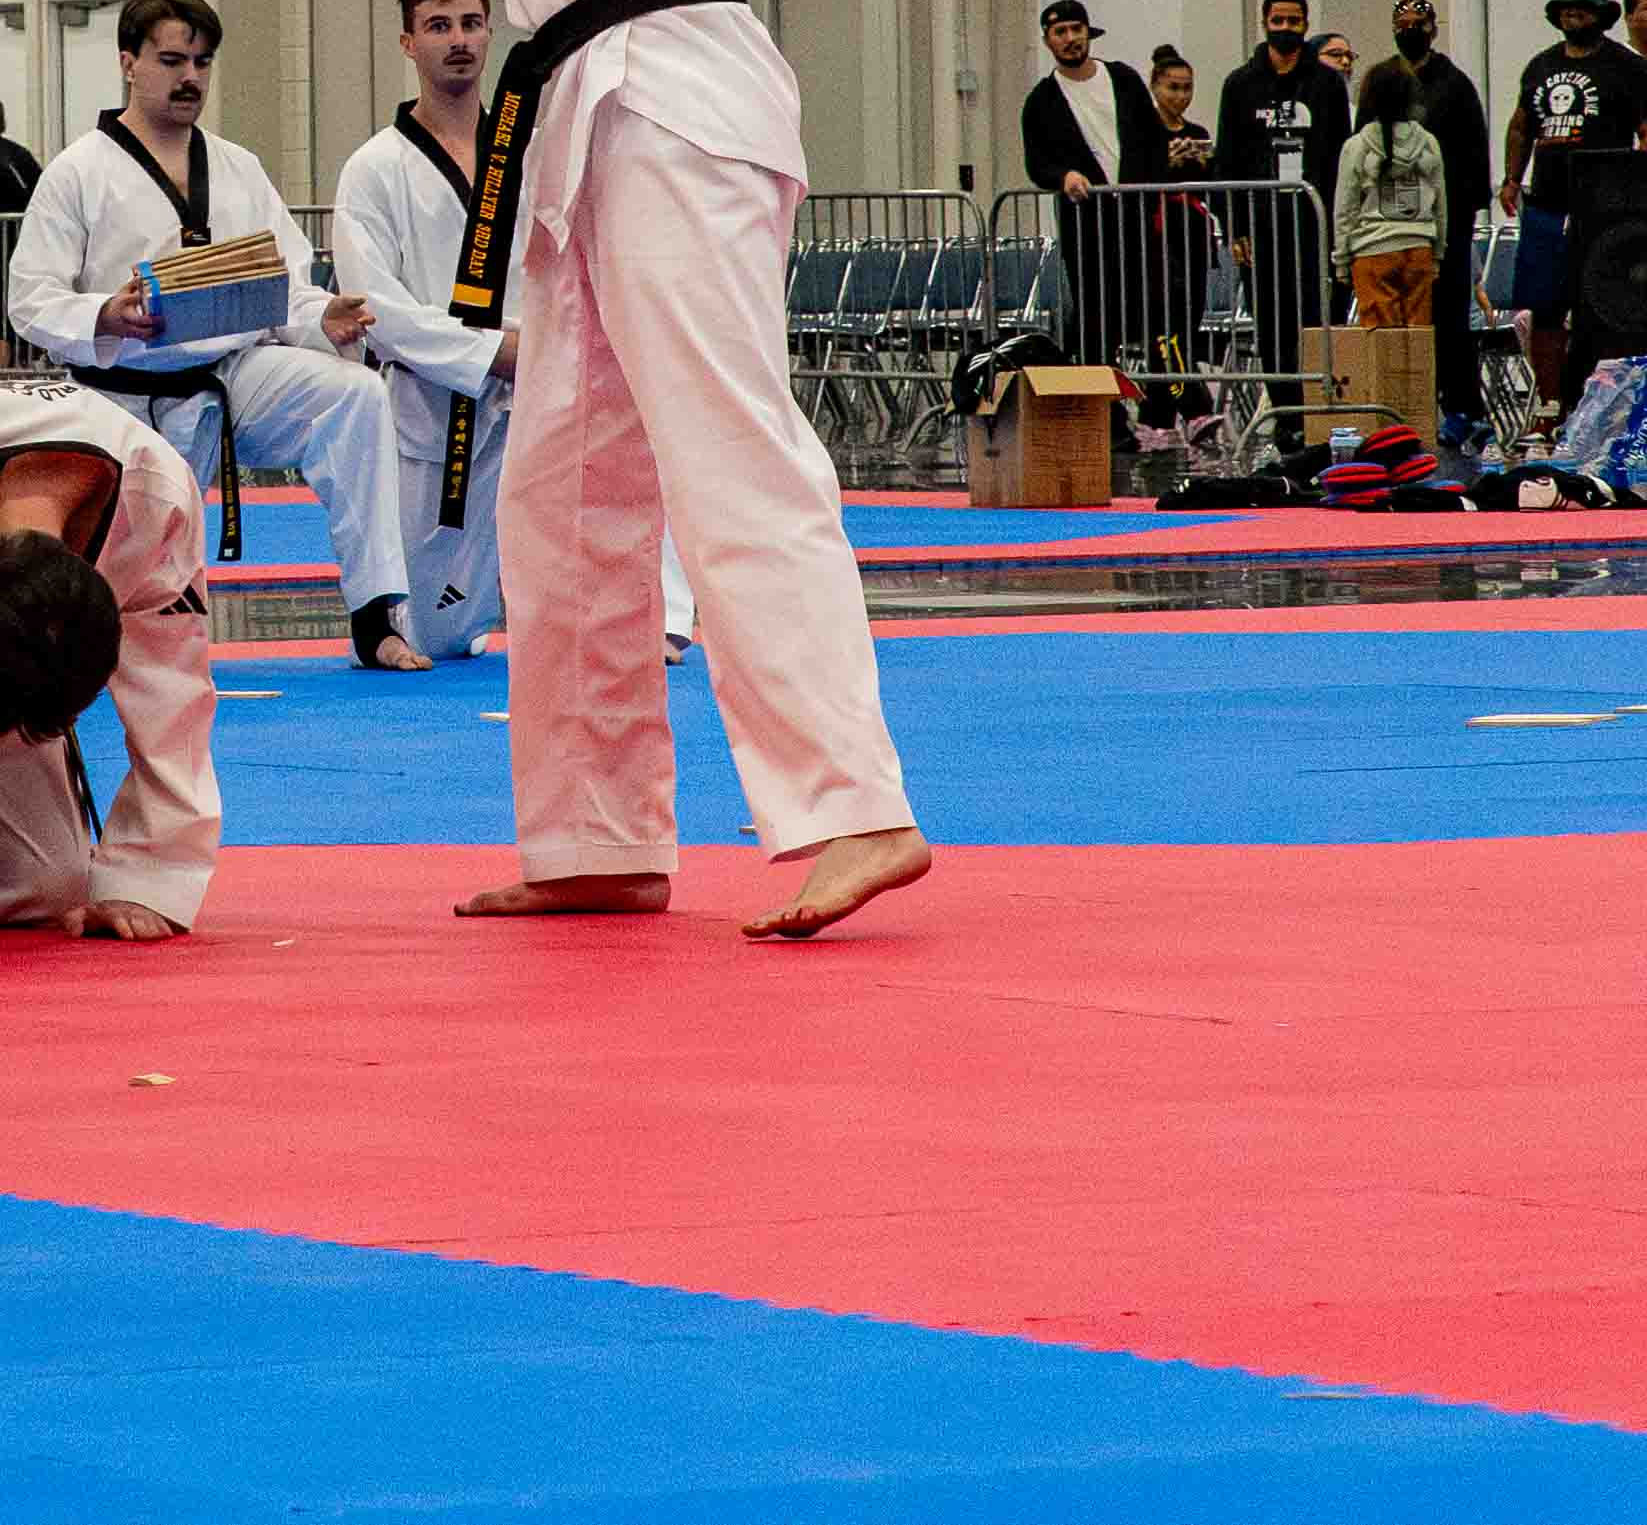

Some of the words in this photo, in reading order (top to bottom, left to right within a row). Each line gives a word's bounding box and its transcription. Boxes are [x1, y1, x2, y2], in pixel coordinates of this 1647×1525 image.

[494, 91, 522, 147] MICHAEL
[474, 223, 492, 249] 3RD
[468, 248, 487, 279] DAN
